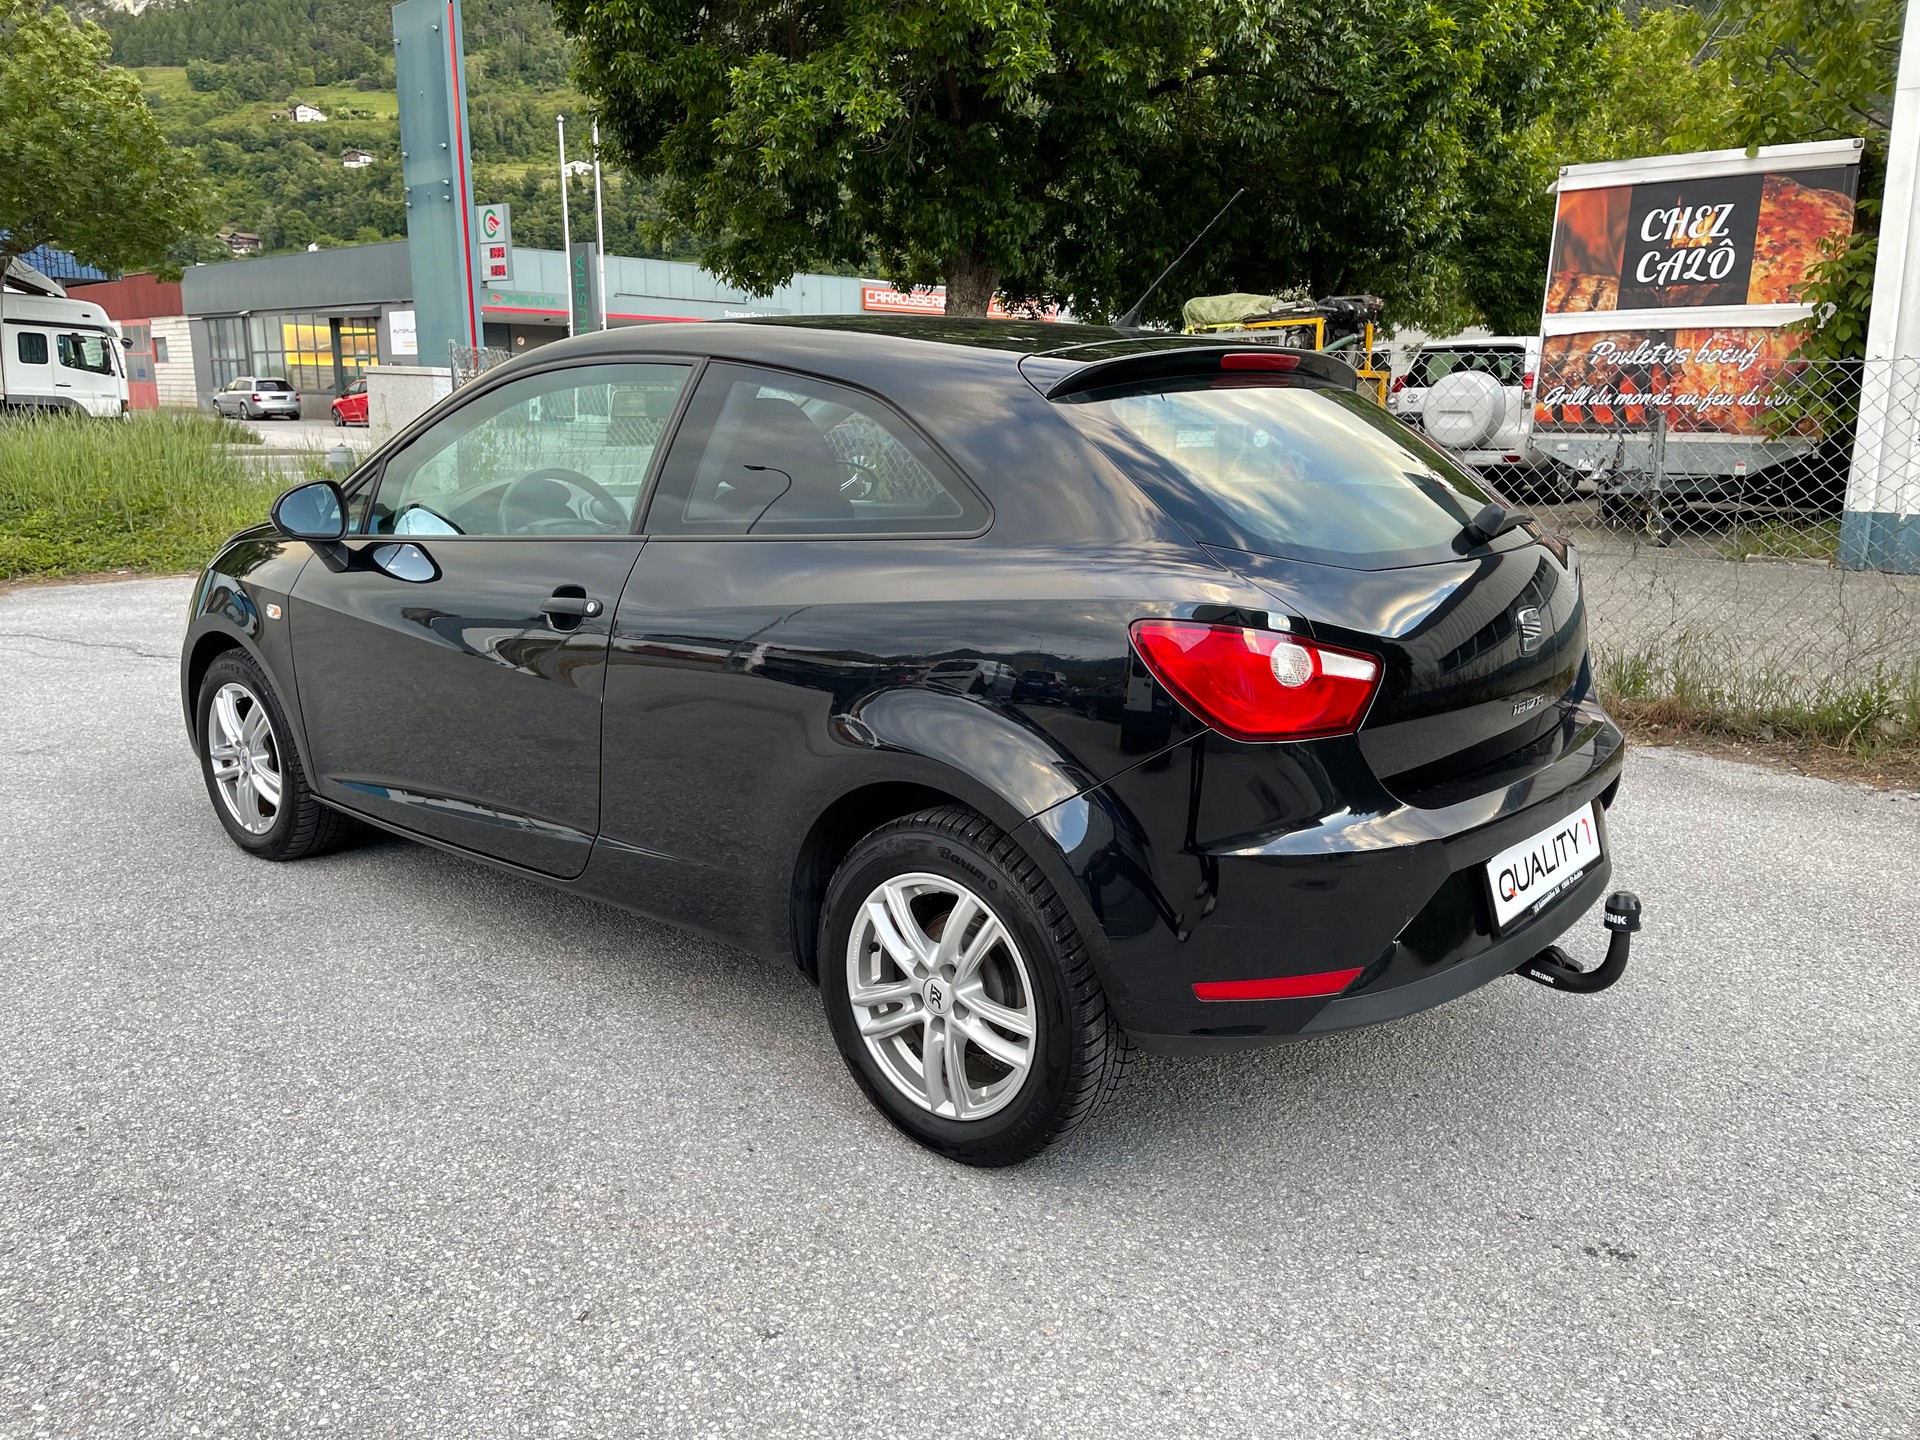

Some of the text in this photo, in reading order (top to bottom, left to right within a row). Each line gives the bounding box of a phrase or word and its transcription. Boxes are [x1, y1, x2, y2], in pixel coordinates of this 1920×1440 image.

[1641, 204, 1735, 242] CHEZ
[1636, 238, 1736, 286] CALÔ
[487, 291, 557, 306] COMBUSTIA
[1589, 339, 1666, 366] Poulet
[1543, 386, 1590, 411] Grill
[1588, 384, 1614, 406] du
[1613, 384, 1673, 406] monde
[1674, 393, 1700, 406] au
[1697, 384, 1736, 413] feu
[1512, 693, 1545, 716] IBIZA
[937, 846, 988, 883] Barum
[1499, 823, 1579, 902] QUALITY
[1604, 911, 1627, 925] RINK
[1530, 969, 1555, 984] BRINK
